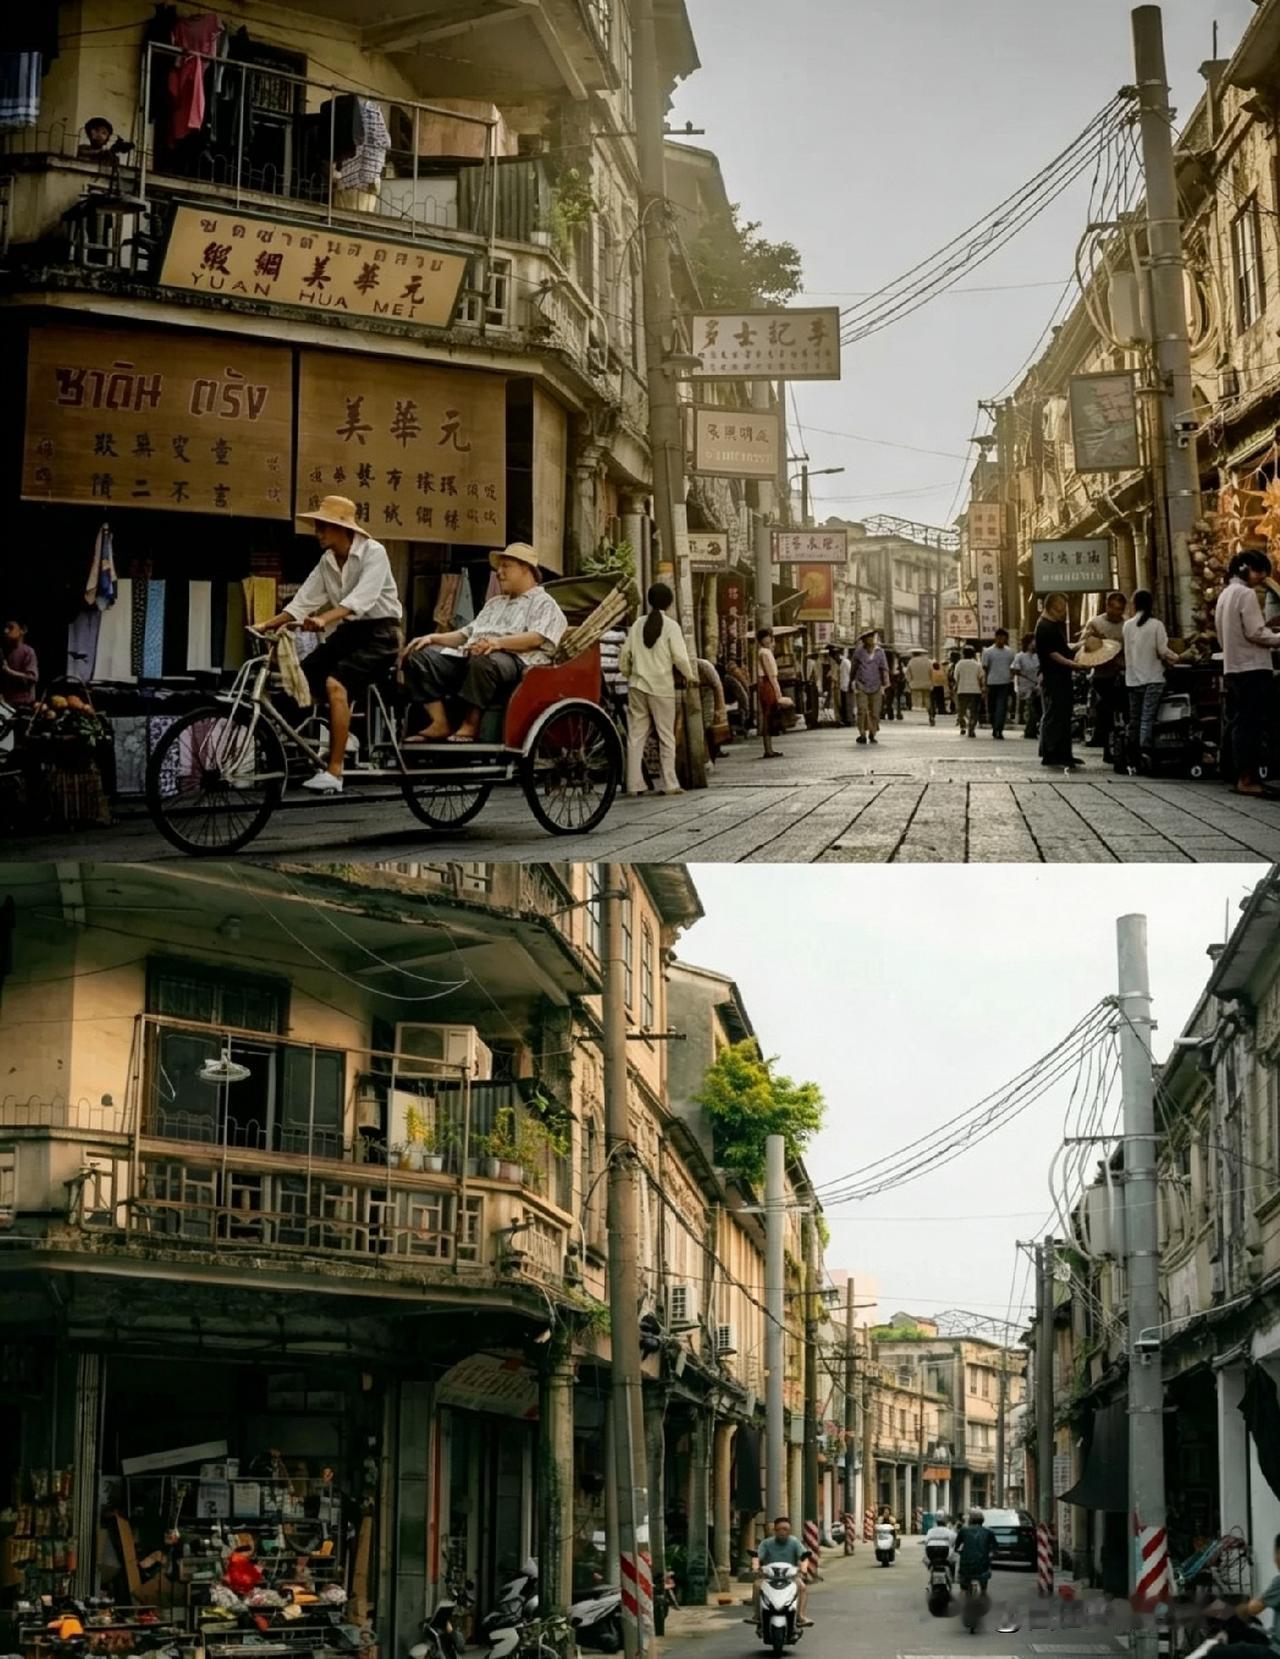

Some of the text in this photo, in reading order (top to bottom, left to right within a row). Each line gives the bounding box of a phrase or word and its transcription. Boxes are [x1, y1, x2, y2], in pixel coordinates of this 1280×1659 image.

[191, 272, 416, 318] YUAN HUA MEI
